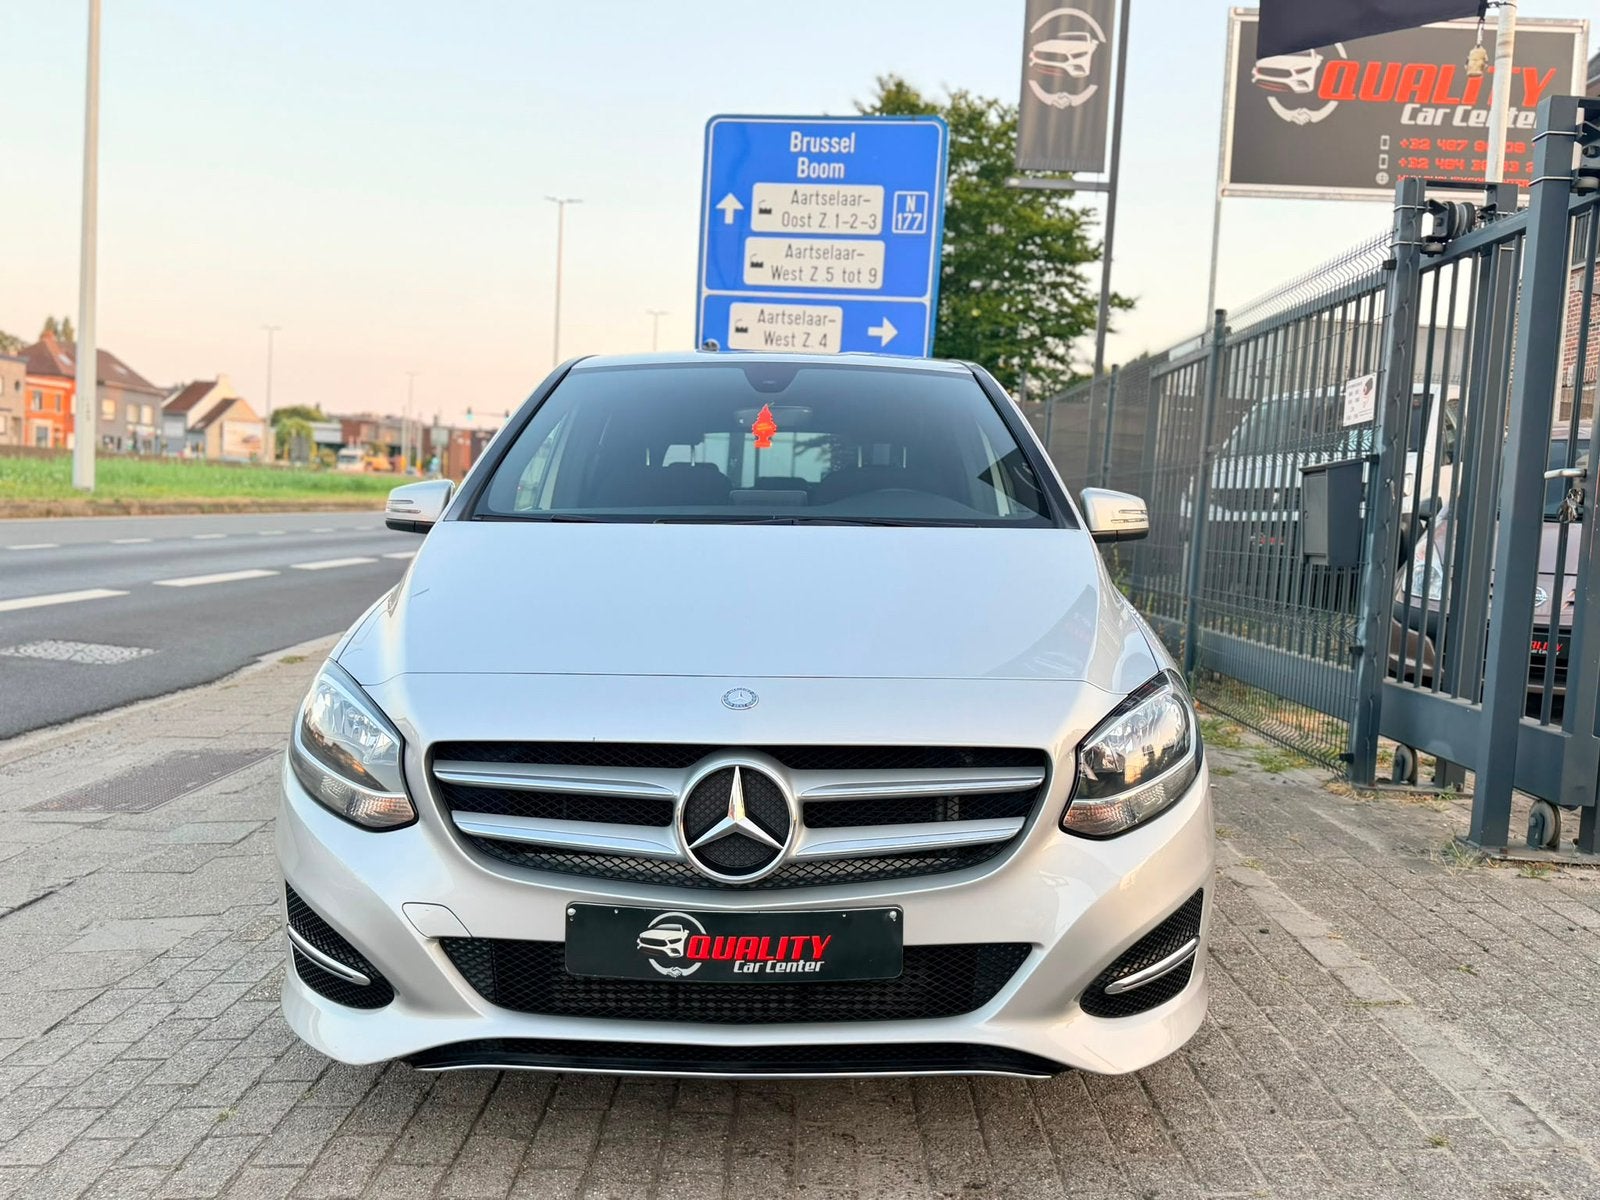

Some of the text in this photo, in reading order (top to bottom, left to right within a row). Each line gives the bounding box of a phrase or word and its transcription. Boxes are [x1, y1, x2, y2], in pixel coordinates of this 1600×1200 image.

[1400, 103, 1537, 129] Car Cete
[790, 131, 856, 153] Brussel
[797, 156, 845, 179] Boom
[790, 189, 871, 207] Aartselaar-
[905, 194, 916, 212] N
[781, 211, 811, 228] Oost
[897, 213, 922, 231] 177
[785, 243, 865, 261] Aartselaar-
[770, 264, 803, 281] West
[842, 267, 862, 284] tot
[868, 267, 878, 284] 9
[757, 308, 836, 326] Aartselaar-
[763, 330, 796, 347] West
[819, 333, 827, 348] 4
[686, 935, 832, 960] QUALITY
[733, 959, 825, 973] Car Center
